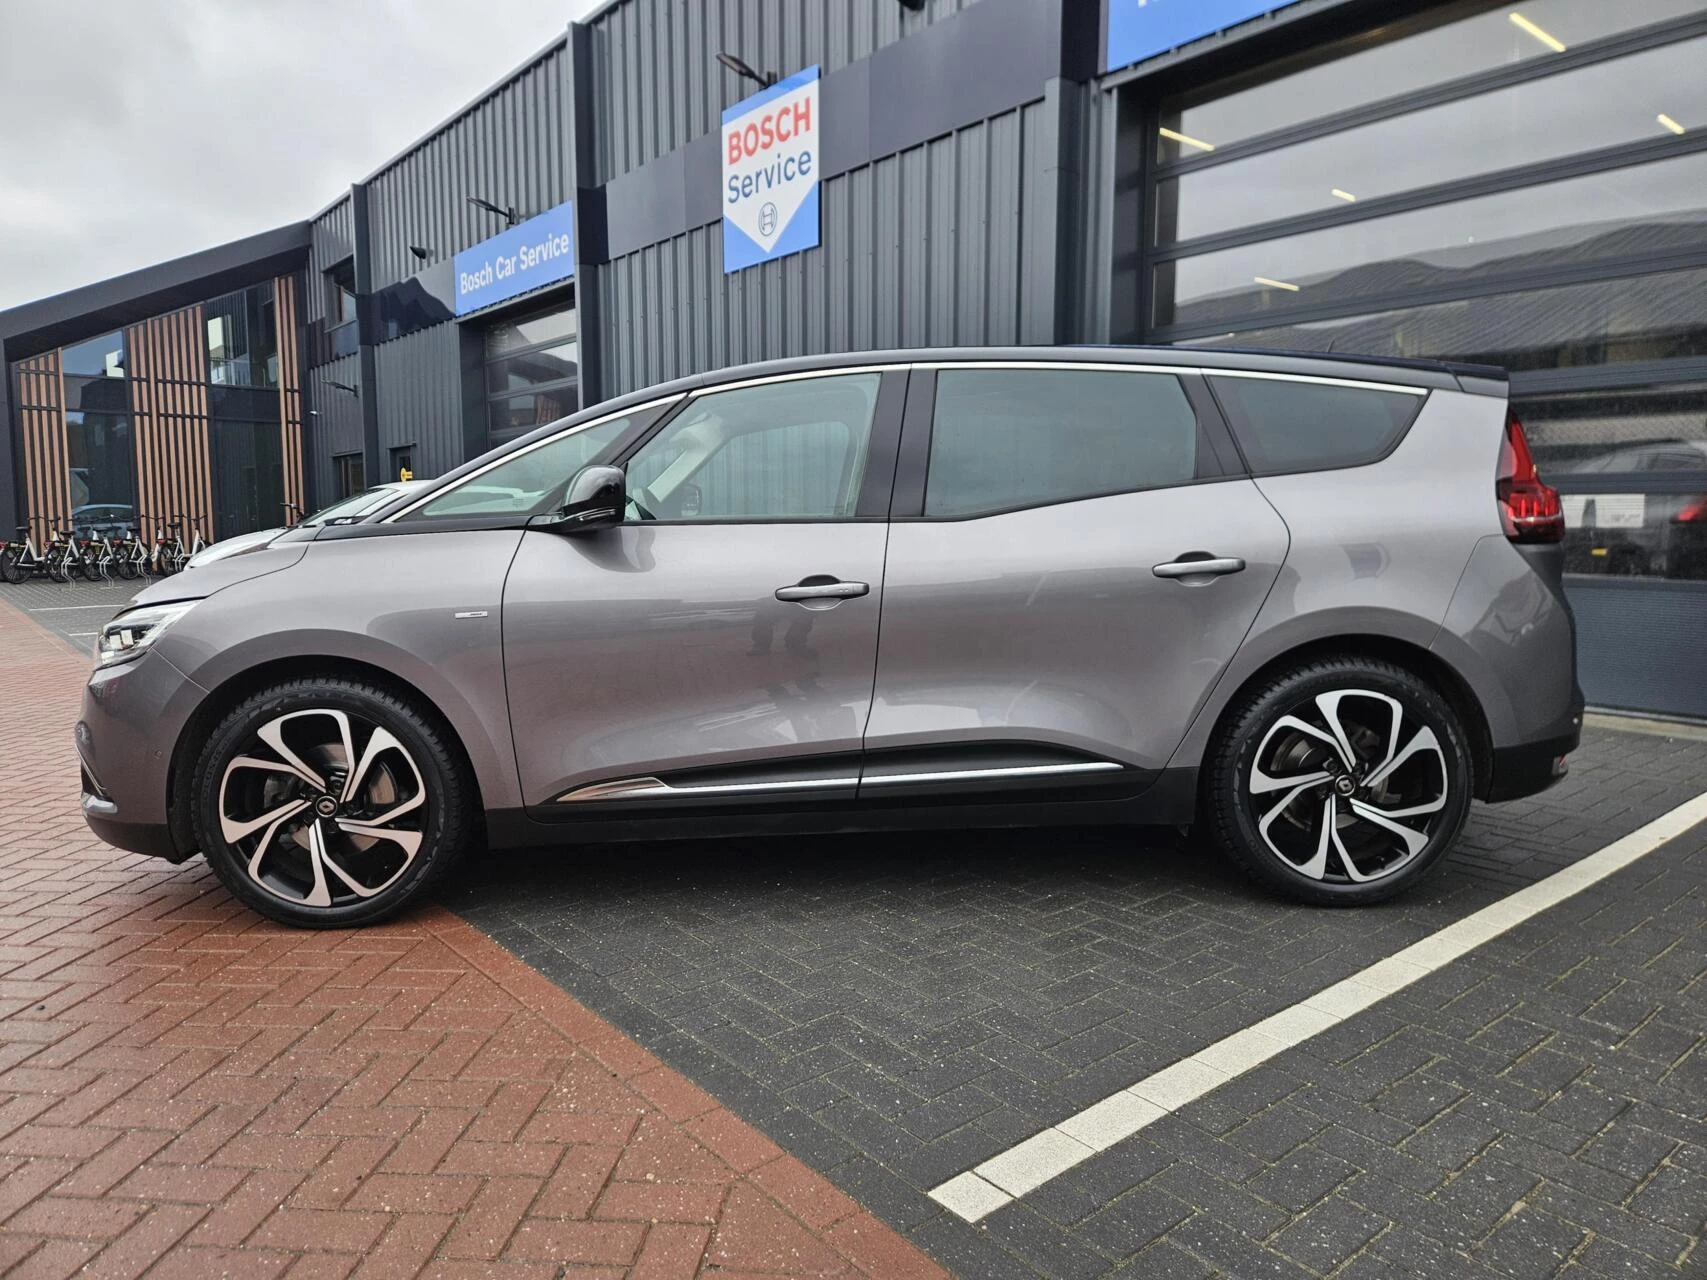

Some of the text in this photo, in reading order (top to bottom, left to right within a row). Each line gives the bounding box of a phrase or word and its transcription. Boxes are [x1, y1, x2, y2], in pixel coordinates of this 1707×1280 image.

[728, 96, 811, 165] BOSCH
[728, 150, 812, 204] Service
[460, 232, 569, 295] Bosch Car Service
